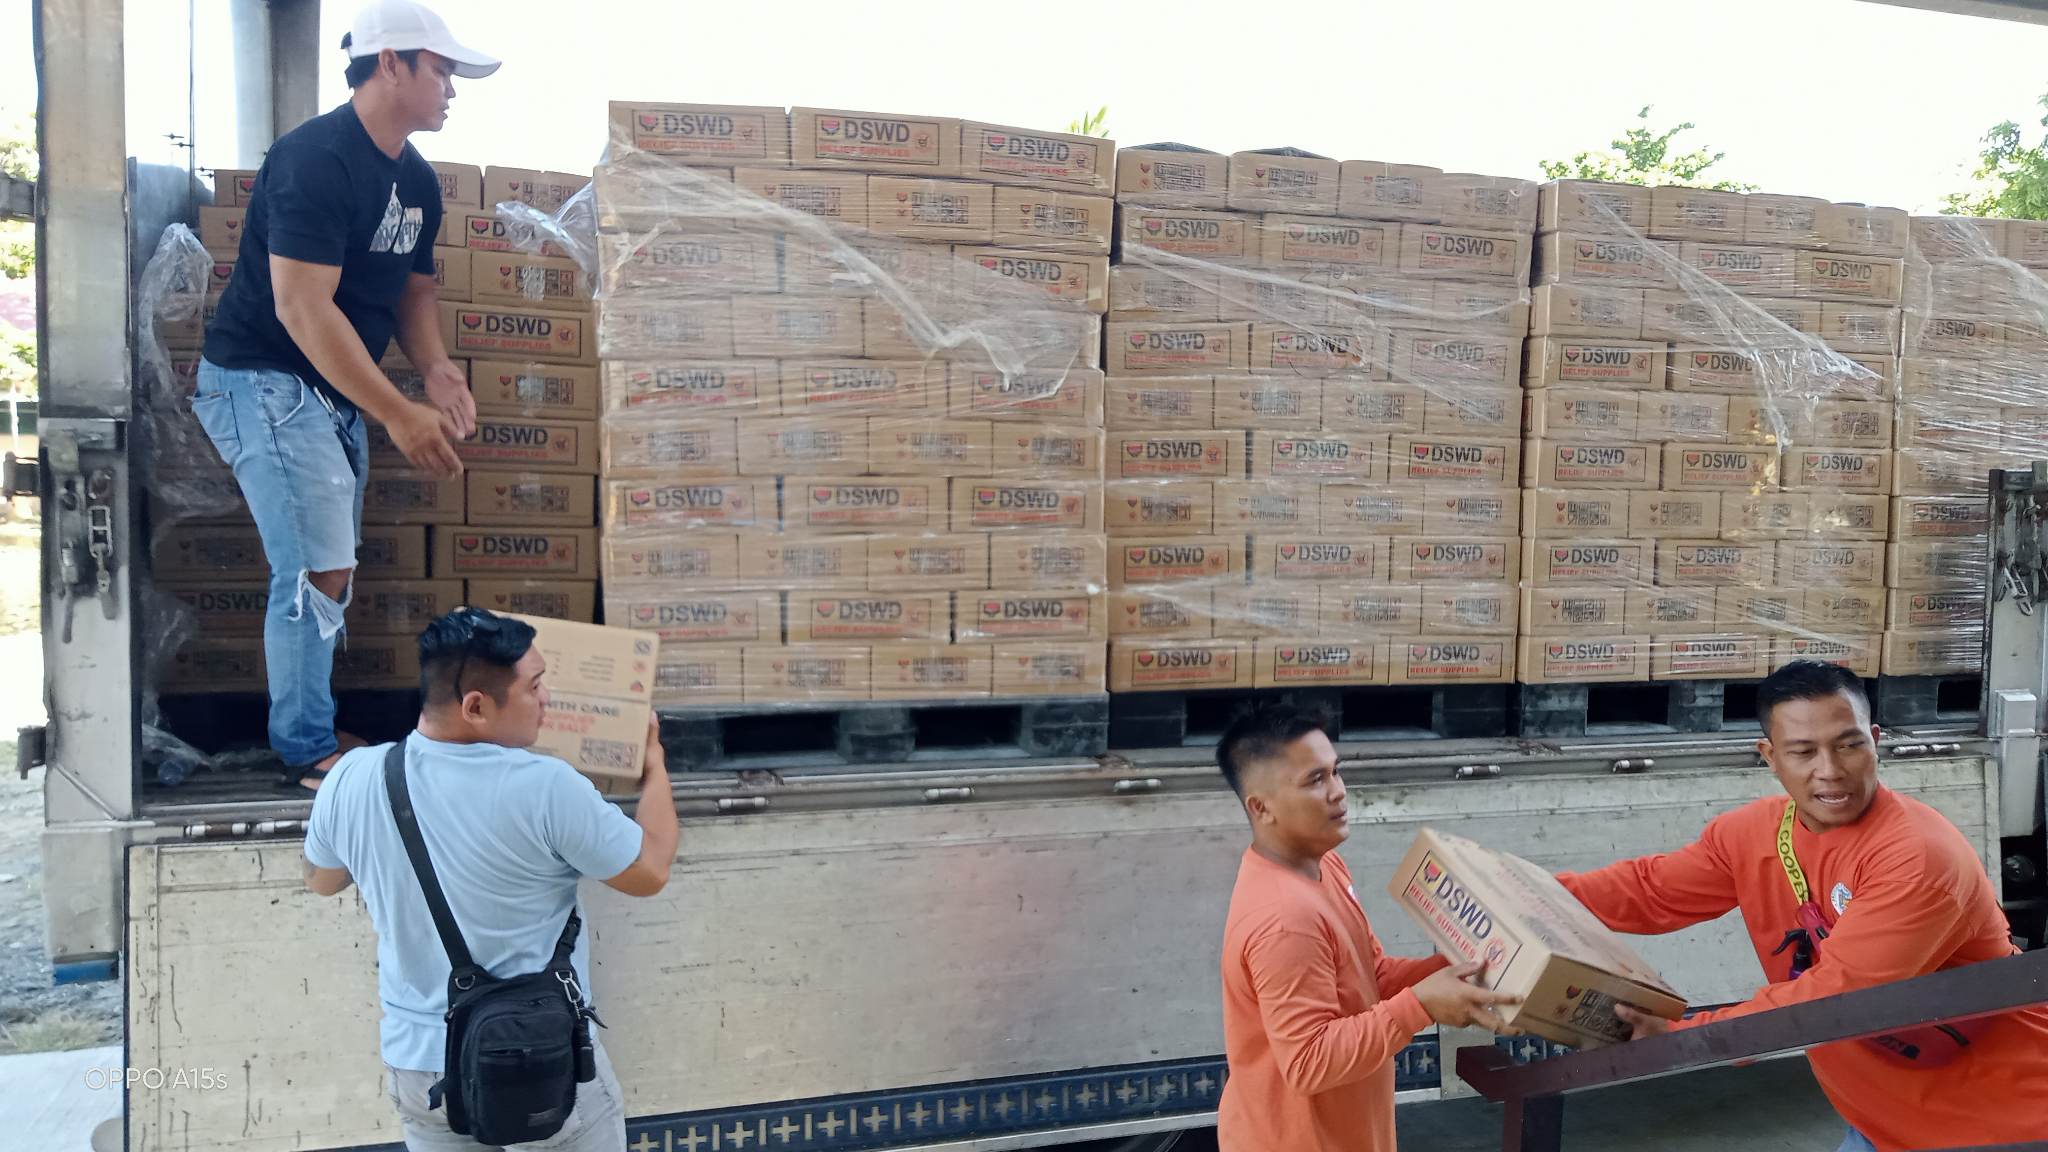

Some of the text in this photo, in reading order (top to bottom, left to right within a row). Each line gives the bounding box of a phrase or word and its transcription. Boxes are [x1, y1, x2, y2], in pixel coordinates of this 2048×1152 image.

[663, 114, 734, 136] DSWD
[844, 120, 911, 143] DSWD
[1007, 137, 1070, 162] DSWD
[1165, 220, 1220, 239] DSWD
[1306, 228, 1360, 246] DSWD
[652, 243, 722, 265] DSWD
[1444, 235, 1494, 256] DSWD
[1595, 244, 1643, 262] DSWD
[1717, 253, 1763, 269] DSWD
[1830, 260, 1872, 280] DSWD
[1000, 259, 1062, 282] DSWD
[486, 315, 552, 336] DSWD
[1936, 321, 1976, 336] DSWD
[1150, 334, 1206, 351] DSWD
[1296, 335, 1350, 354] DSWD
[1434, 344, 1485, 361] DSWD
[1582, 348, 1631, 365] DSWD
[656, 367, 725, 389] DSWD
[832, 368, 897, 390] DSWD
[483, 426, 548, 445] DSWD
[1147, 442, 1203, 459] DSWD
[1295, 442, 1349, 459] DSWD
[1431, 446, 1482, 463] DSWD
[1577, 449, 1625, 465] DSWD
[1702, 453, 1747, 470] DSWD
[1821, 455, 1863, 471] DSWD
[655, 487, 723, 507] DSWD
[836, 488, 899, 507] DSWD
[1000, 488, 1060, 508] DSWD
[483, 536, 549, 554] DSWD
[1298, 545, 1351, 562] DSWD
[1433, 545, 1483, 562] DSWD
[1150, 547, 1205, 565] DSWD
[1571, 549, 1619, 565] DSWD
[1696, 548, 1742, 565] DSWD
[1811, 550, 1855, 566] DSWD
[659, 603, 728, 624] DSWD
[838, 600, 902, 620] DSWD
[1004, 600, 1064, 619] DSWD
[1157, 649, 1212, 667] DSWD
[1298, 646, 1351, 665] DSWD
[1429, 645, 1480, 662] DSWD
[1565, 643, 1615, 660] DSWD
[1691, 642, 1737, 658] DSWD
[580, 703, 620, 717] CARE
[1436, 875, 1492, 940] DSWD
[1409, 883, 1477, 960] RELIEF SUPPLIES
